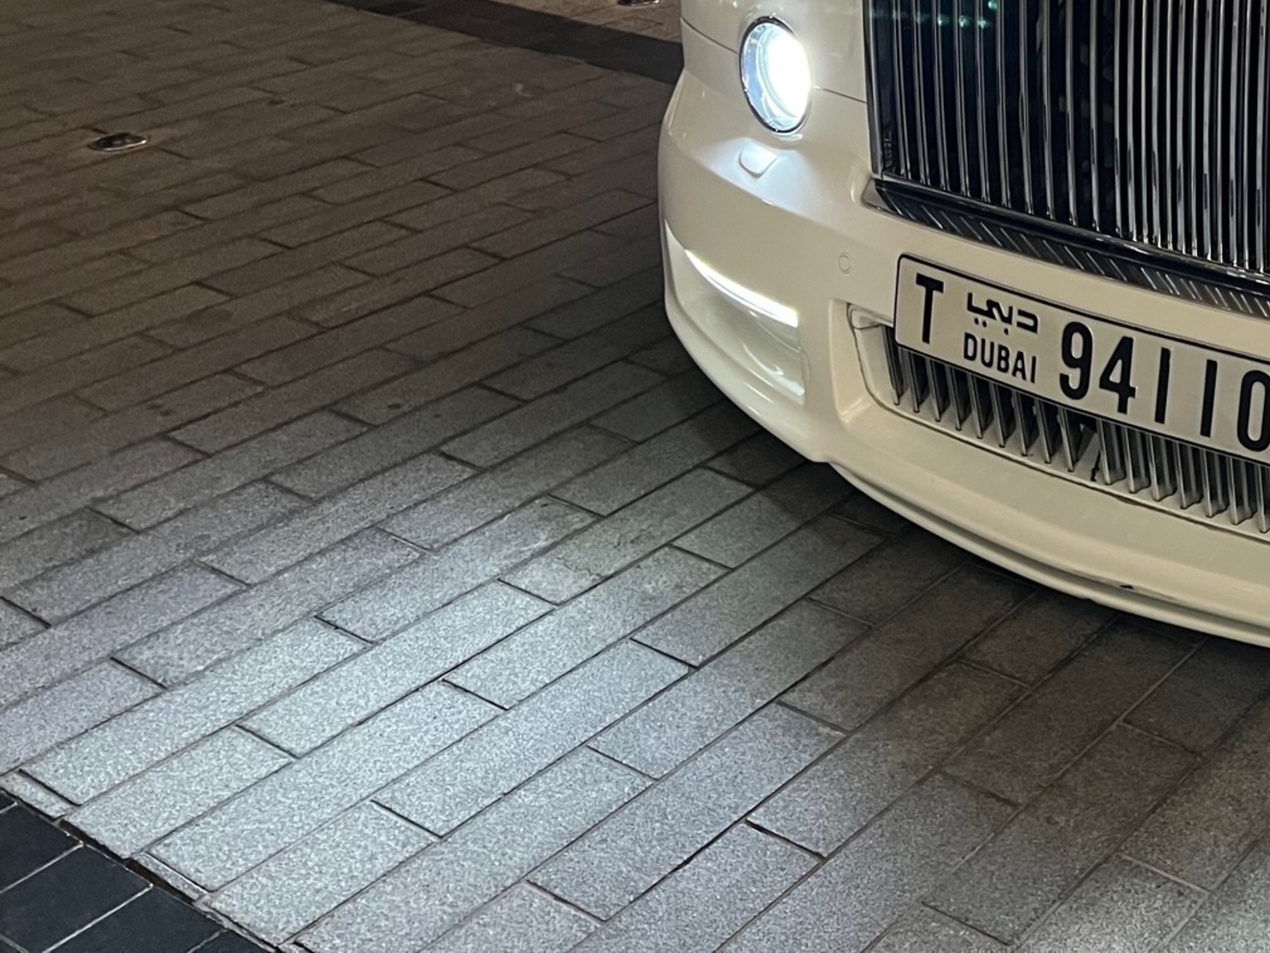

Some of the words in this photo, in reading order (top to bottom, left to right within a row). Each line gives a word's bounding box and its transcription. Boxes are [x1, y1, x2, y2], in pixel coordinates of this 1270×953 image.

[915, 272, 944, 345] T
[966, 291, 1039, 336] دبي
[963, 331, 1038, 384] DUBAI
